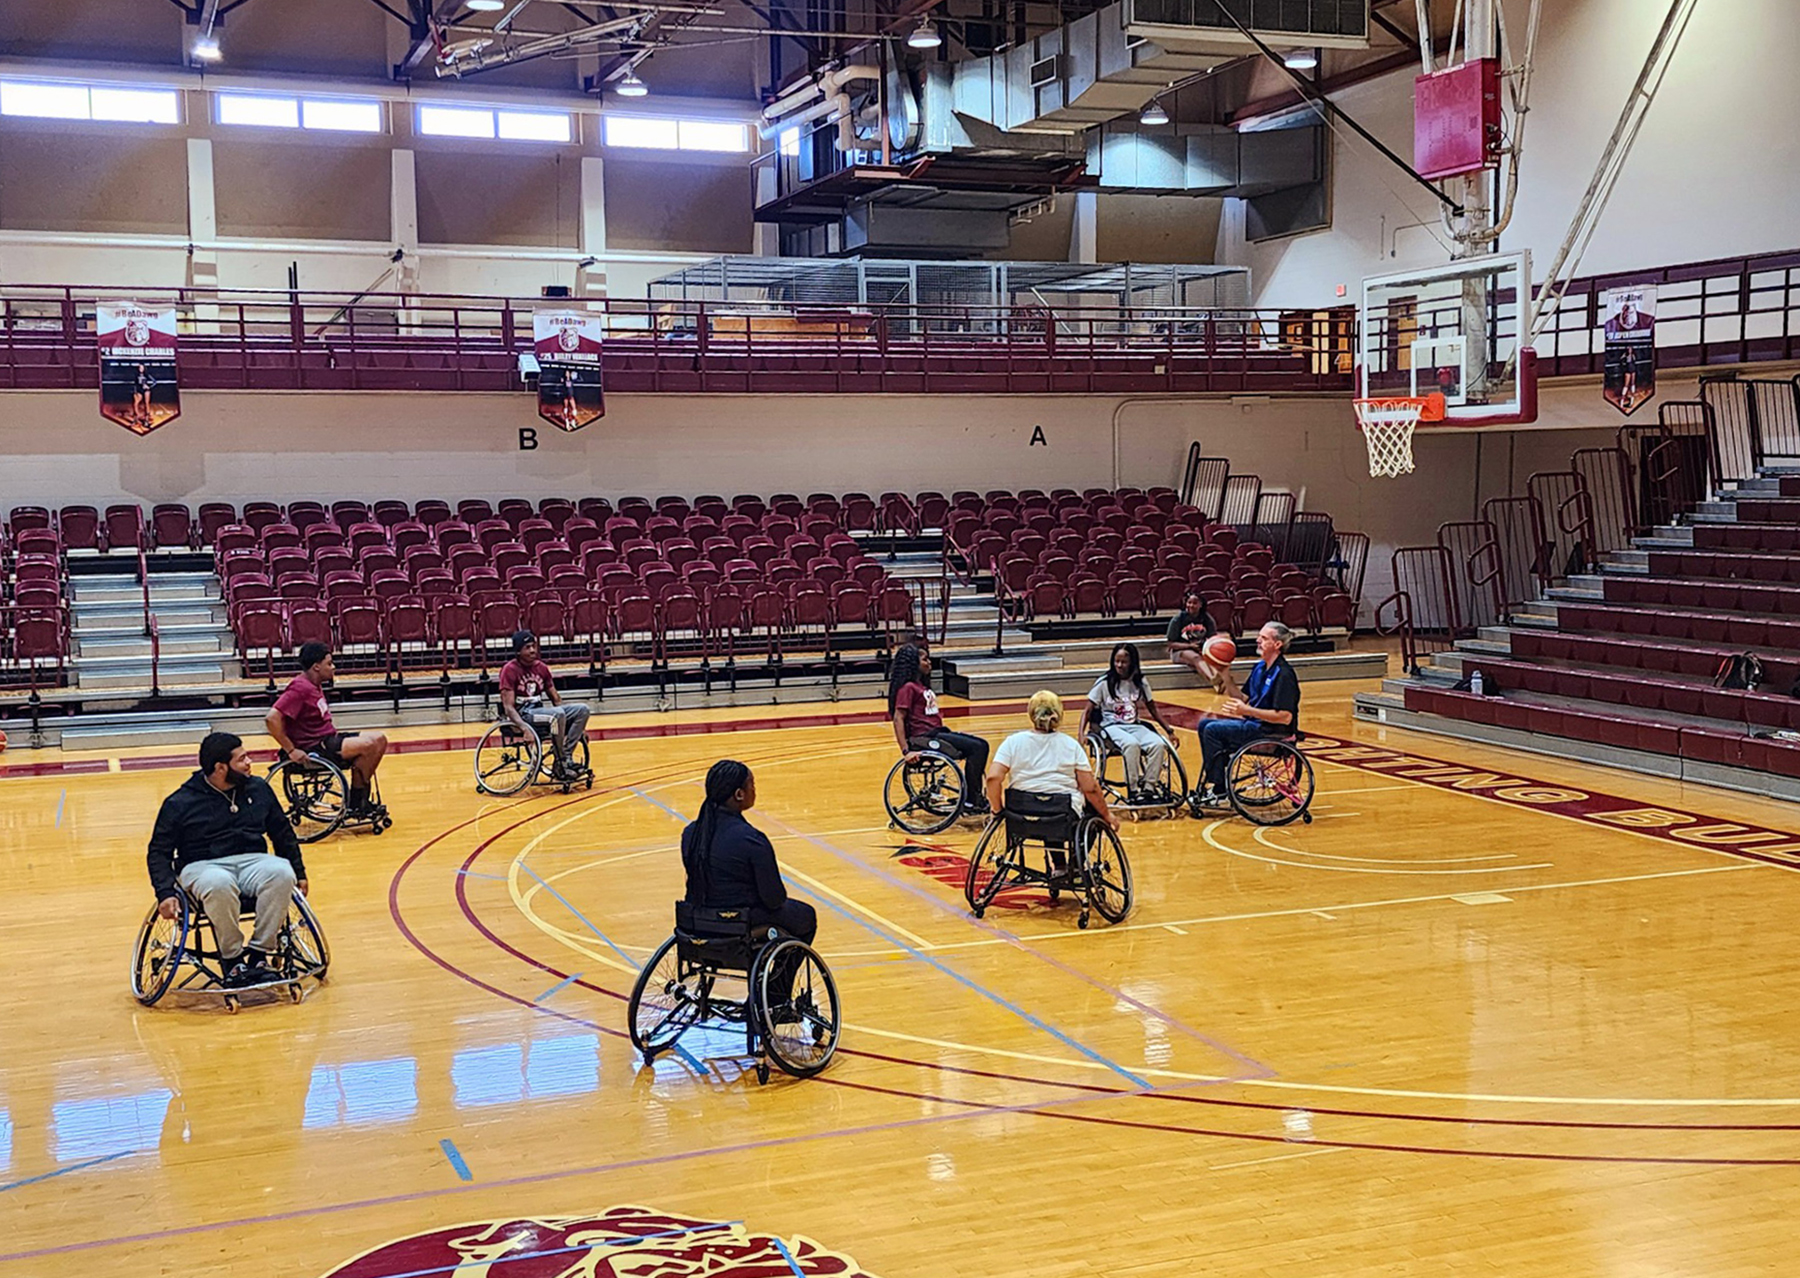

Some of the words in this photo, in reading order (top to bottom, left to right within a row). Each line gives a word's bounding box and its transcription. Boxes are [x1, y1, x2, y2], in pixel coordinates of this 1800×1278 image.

[115, 309, 158, 319] #BeADawg
[519, 428, 538, 450] B
[1029, 425, 1047, 446] A
